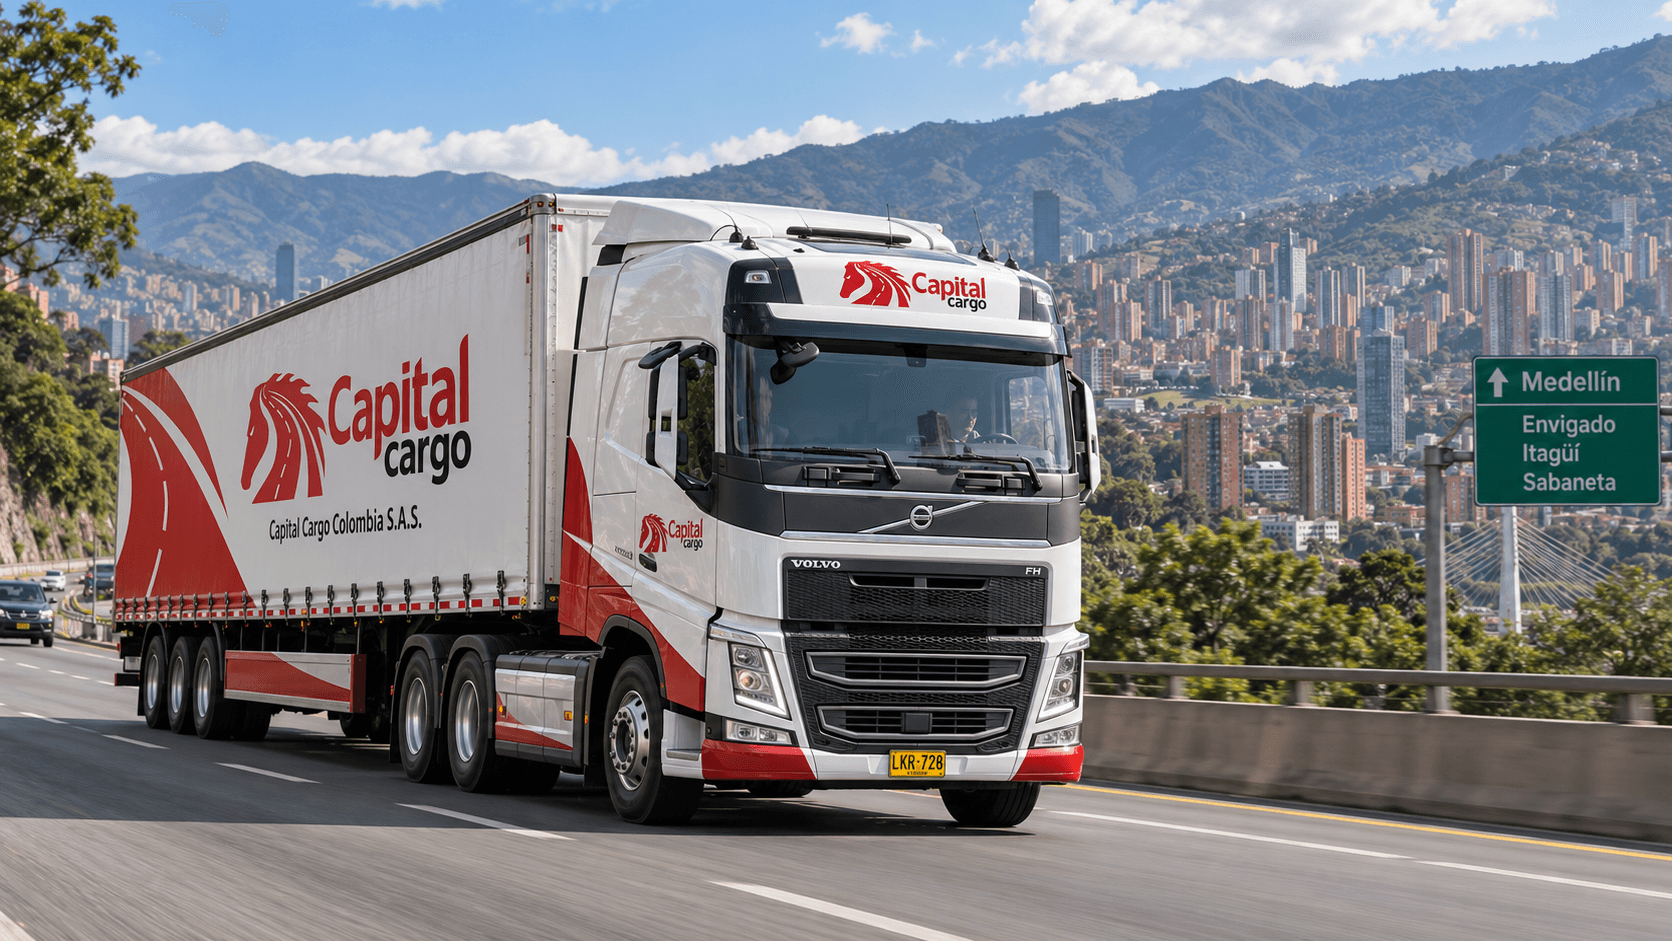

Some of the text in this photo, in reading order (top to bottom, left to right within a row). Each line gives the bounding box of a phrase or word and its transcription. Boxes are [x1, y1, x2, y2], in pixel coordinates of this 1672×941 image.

[911, 272, 986, 301] Capital
[947, 297, 987, 312] cargo
[1522, 370, 1621, 392] Medellín
[328, 333, 470, 461] Capital
[1523, 414, 1616, 438] Envigado
[384, 430, 472, 486] cargo
[1523, 442, 1581, 467] Itagüí
[1523, 472, 1616, 491] Sabaneta
[269, 504, 422, 545] Capital Cargo Colombia S.A.S.
[668, 518, 704, 544] Capital
[683, 538, 703, 552] cargo
[791, 559, 841, 570] VOLVO
[1025, 567, 1042, 576] FH
